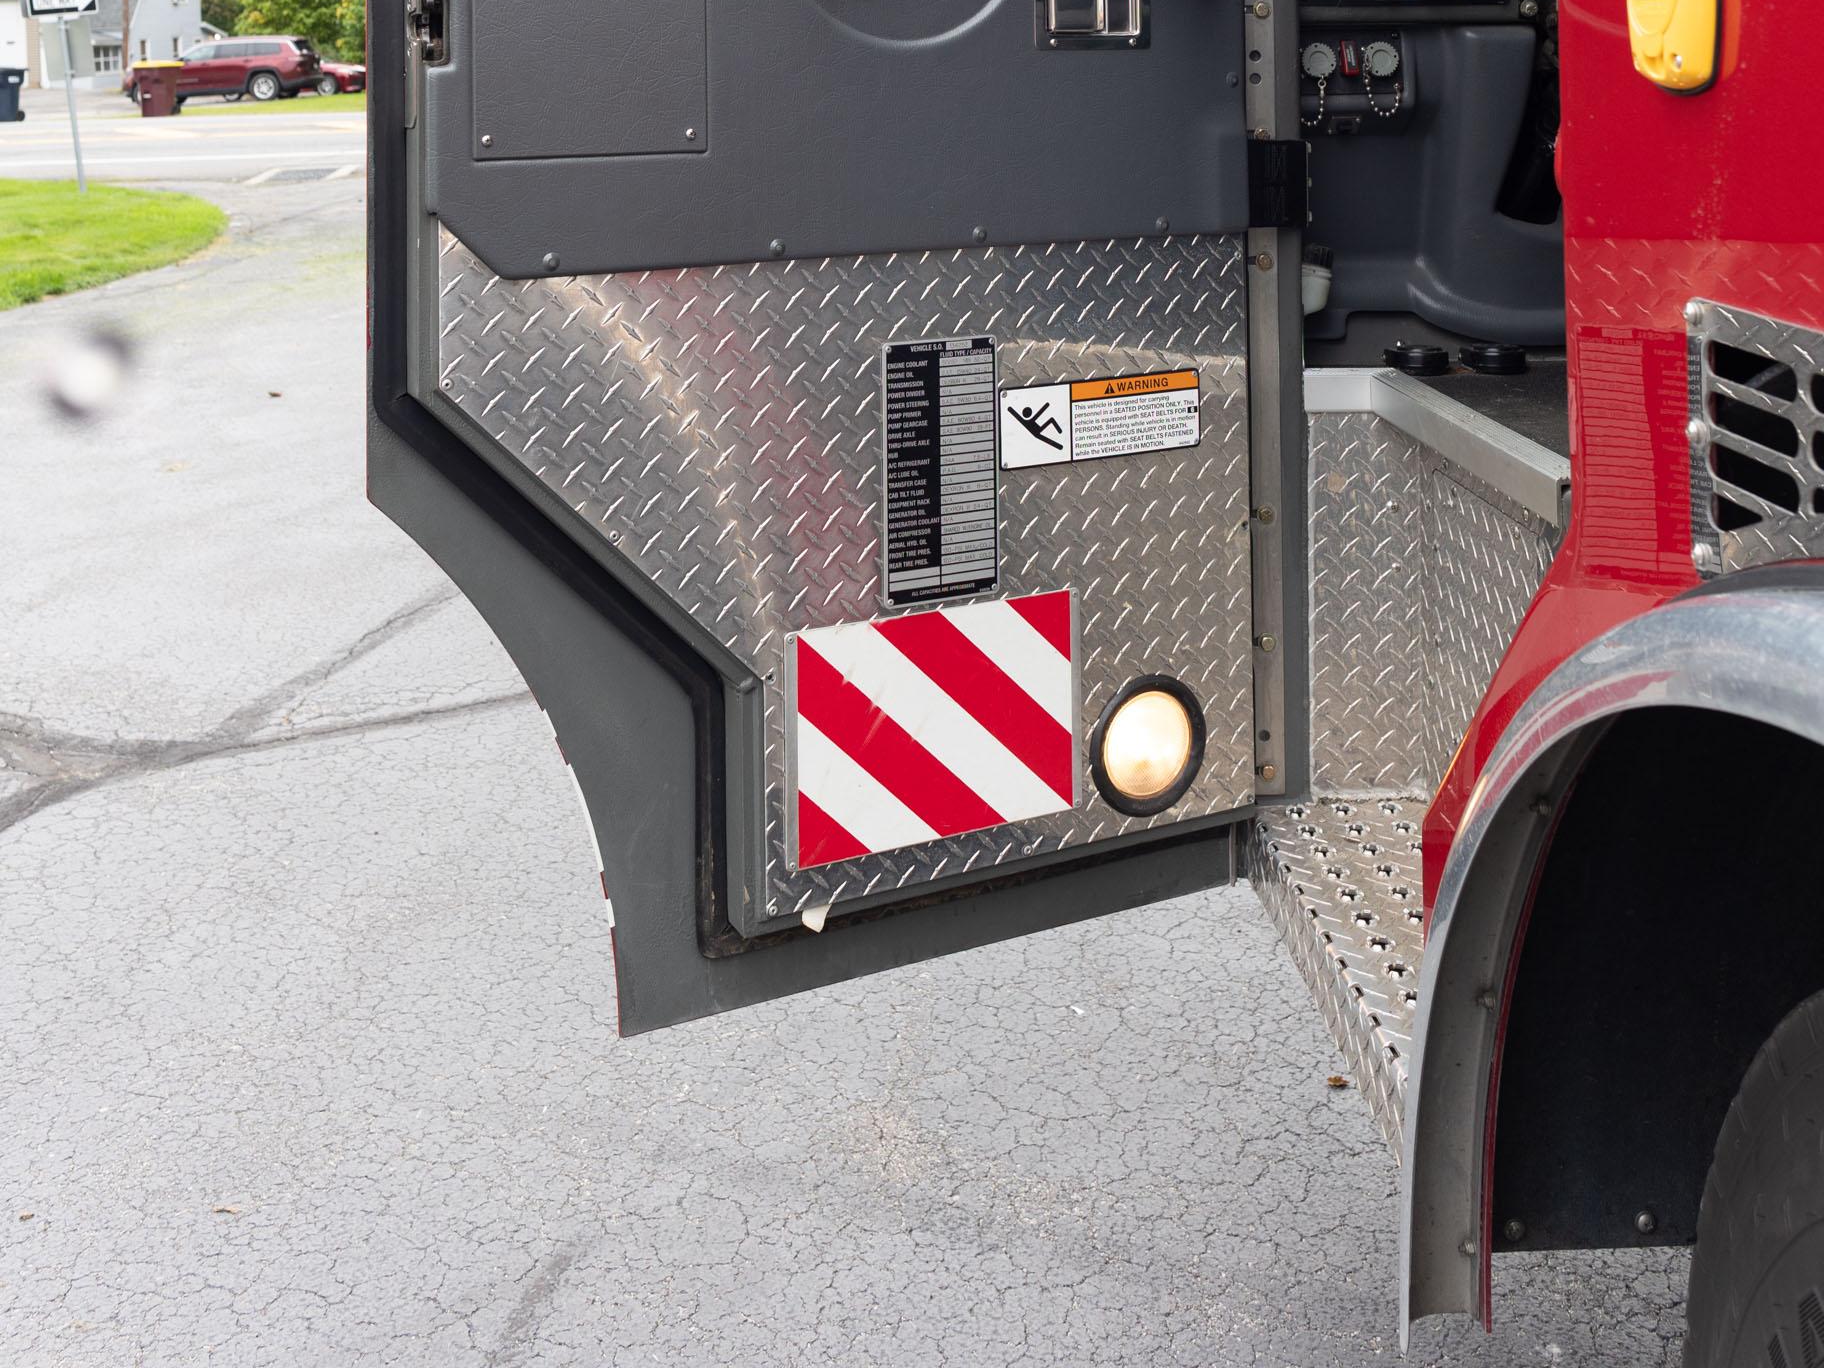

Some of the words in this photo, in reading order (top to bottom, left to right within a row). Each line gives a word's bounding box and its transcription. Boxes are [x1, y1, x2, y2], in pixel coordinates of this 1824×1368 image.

[910, 344, 932, 352] VEHICLE
[954, 349, 966, 357] TYPE
[970, 347, 992, 355] CAPACITY
[888, 380, 924, 389] TRANSMISSION
[1117, 378, 1169, 392] WARNING
[905, 390, 925, 398] DIVIDER
[906, 400, 929, 408] STEERING
[1113, 399, 1138, 408] designed
[1148, 395, 1169, 404] carrying
[888, 412, 902, 420] PUMP
[902, 410, 921, 418] PRIMER
[1075, 410, 1101, 419] personnel
[1137, 403, 1164, 411] POSITION
[1165, 401, 1182, 409] ONLY.
[1075, 418, 1094, 426] vehicle
[1101, 415, 1127, 424] equipped
[1156, 409, 1173, 417] BELTS
[903, 420, 928, 428] GEARCASE
[1075, 425, 1104, 434] PERSONS.
[1105, 422, 1130, 431] Standing
[1109, 429, 1135, 437] SERIOUS
[1136, 426, 1156, 434] INJURY
[1167, 422, 1188, 430] DEATH.
[1075, 441, 1096, 449] Remain
[1130, 434, 1145, 442] SEAT
[1145, 432, 1164, 440] BELTS
[1164, 429, 1194, 438] FASTENED
[888, 440, 917, 449] THRU-DRIVE
[1100, 444, 1126, 453] VEHICLE
[1140, 439, 1165, 448] MOTION.
[898, 458, 930, 468] REFRIGERANT
[898, 470, 910, 478] LUBE
[888, 480, 913, 489] TRANSFER
[888, 500, 918, 509] EQUIPMENT
[888, 510, 917, 519] GENERATOR
[888, 521, 917, 530] GENERATOR
[918, 517, 940, 526] COOLANT
[897, 528, 931, 538] COMPRESSOR
[889, 540, 906, 549] AERIAL
[889, 551, 905, 559] FRONT
[905, 549, 916, 557] TIRE
[917, 547, 931, 555] PRES.
[889, 561, 902, 569] REAR
[914, 558, 928, 566] PRES.
